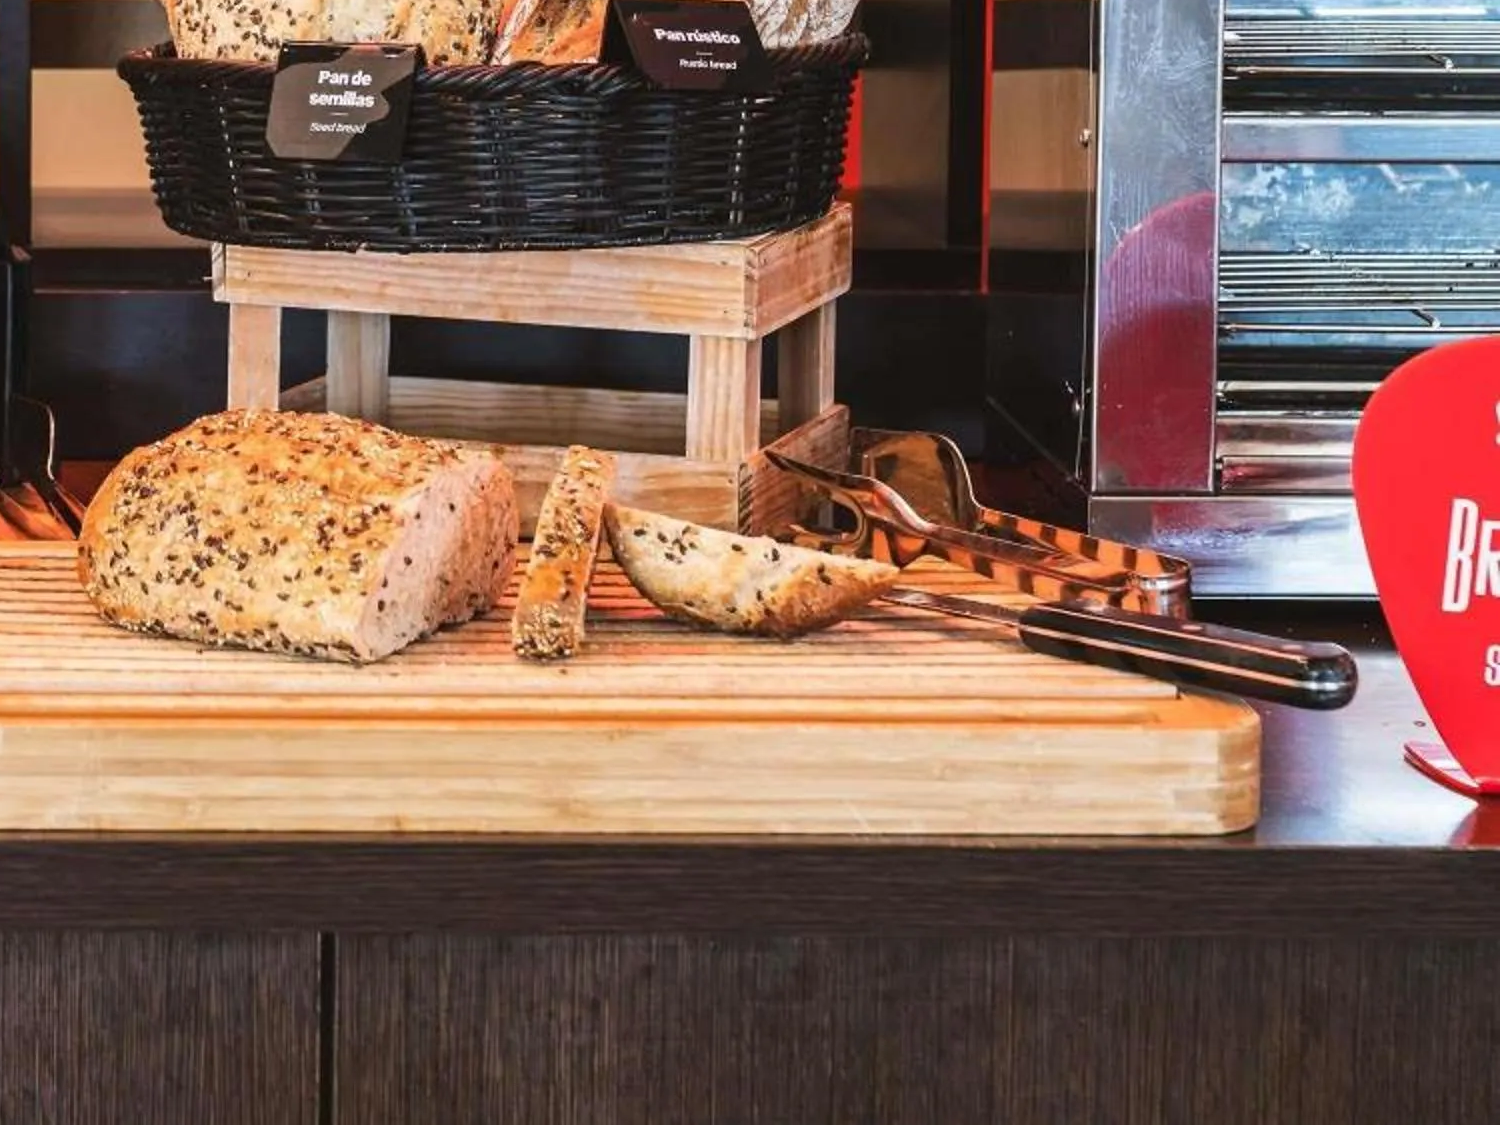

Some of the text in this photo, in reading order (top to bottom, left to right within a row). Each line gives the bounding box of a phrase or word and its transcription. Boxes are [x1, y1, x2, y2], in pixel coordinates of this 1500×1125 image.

[653, 28, 741, 44] Pan rústico
[709, 59, 737, 70] bread
[318, 70, 372, 85] Pan de
[309, 91, 374, 107] semillas
[310, 122, 367, 134] Seed bread
